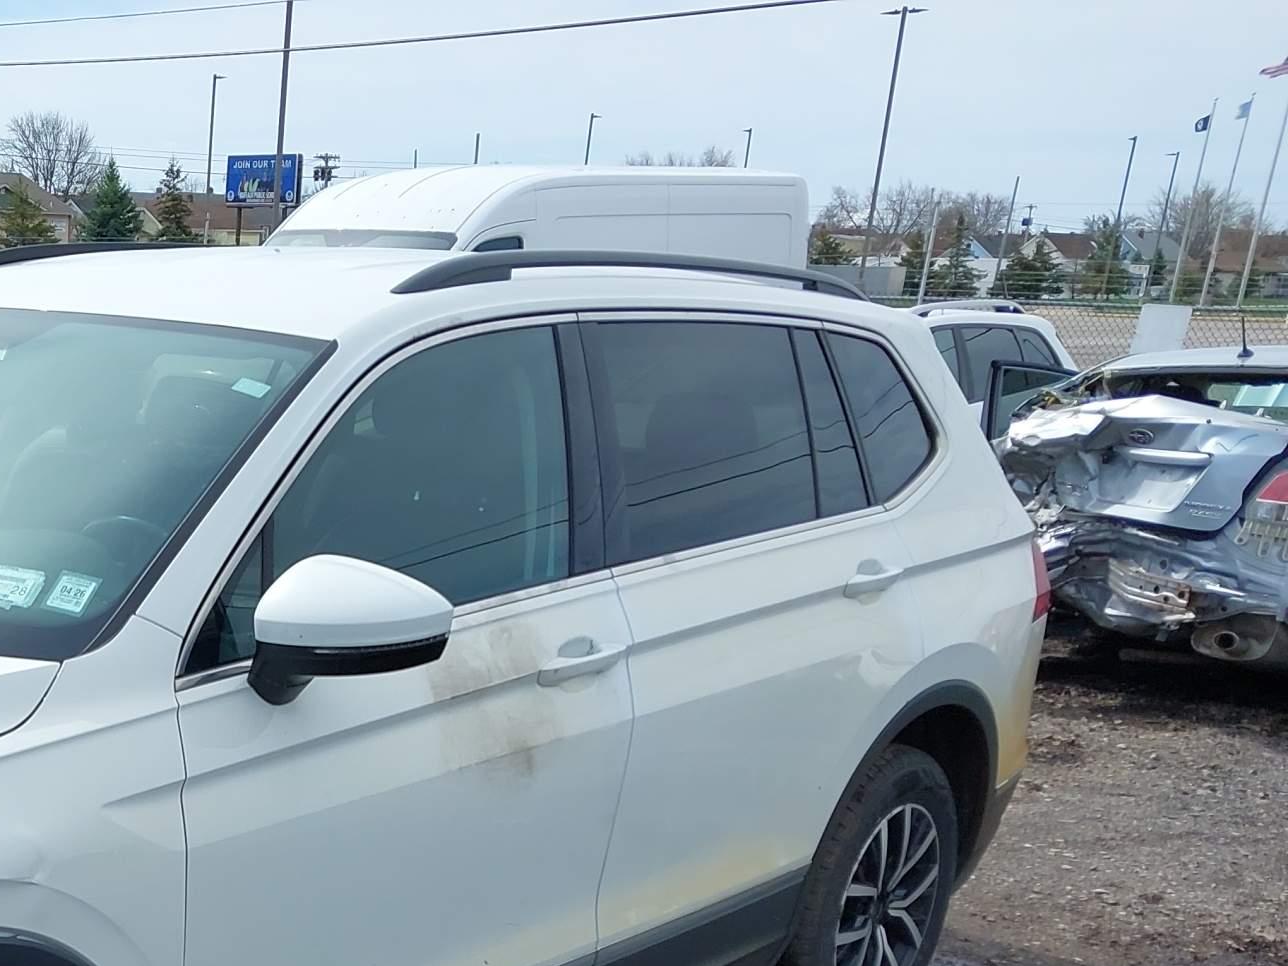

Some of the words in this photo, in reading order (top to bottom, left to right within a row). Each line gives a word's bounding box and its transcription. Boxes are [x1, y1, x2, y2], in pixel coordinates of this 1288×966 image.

[233, 160, 250, 169] JOIN
[252, 159, 269, 169] OUR
[270, 159, 292, 168] TAM
[10, 585, 28, 596] 28
